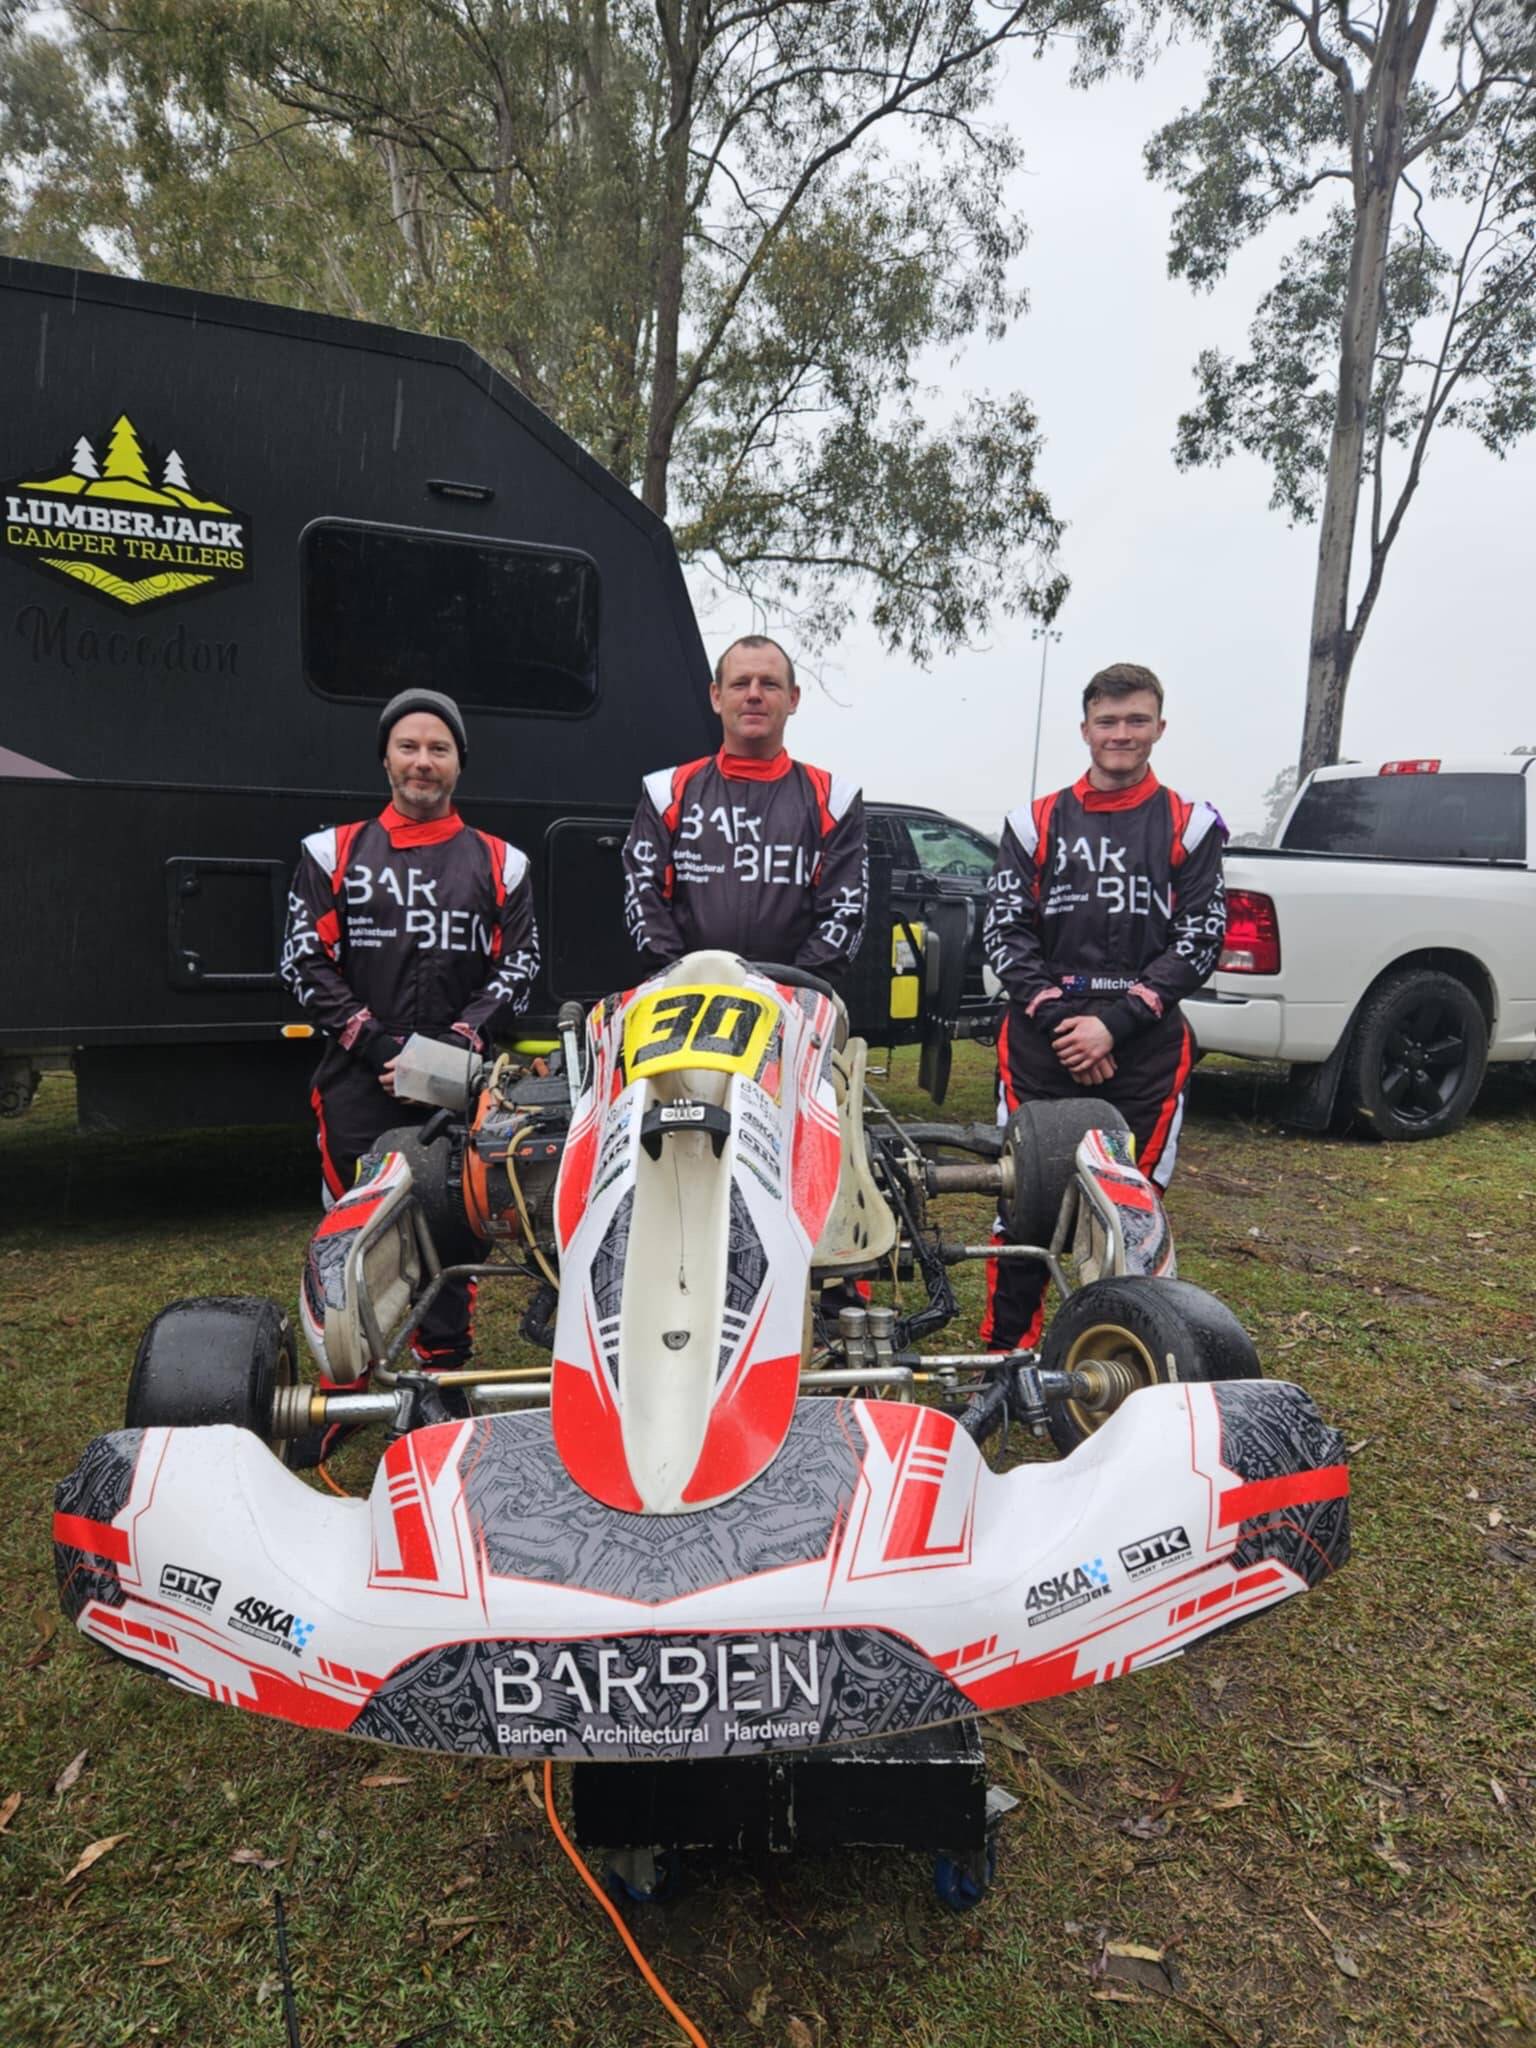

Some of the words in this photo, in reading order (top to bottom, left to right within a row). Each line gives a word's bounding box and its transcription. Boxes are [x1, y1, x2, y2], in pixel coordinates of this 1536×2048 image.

[5, 496, 244, 549] LUMBERJACK
[7, 525, 117, 556] CAMPER
[123, 538, 245, 570] TRAILERS
[680, 803, 762, 844] BAR
[733, 843, 822, 887] BEN
[1053, 836, 1128, 876] BAR
[345, 864, 439, 907] BAR
[1096, 875, 1173, 920] BEN
[404, 909, 494, 957] BEN
[631, 993, 762, 1067] 30
[1120, 1527, 1189, 1570] OTK
[161, 1565, 221, 1603] OTK
[1024, 1567, 1093, 1612] 4SKA
[233, 1596, 295, 1638] 4SKA
[493, 1639, 821, 1714] BARBEN
[497, 1723, 568, 1745] Barben
[581, 1723, 709, 1745] Architectural
[723, 1718, 821, 1742] Hardware
